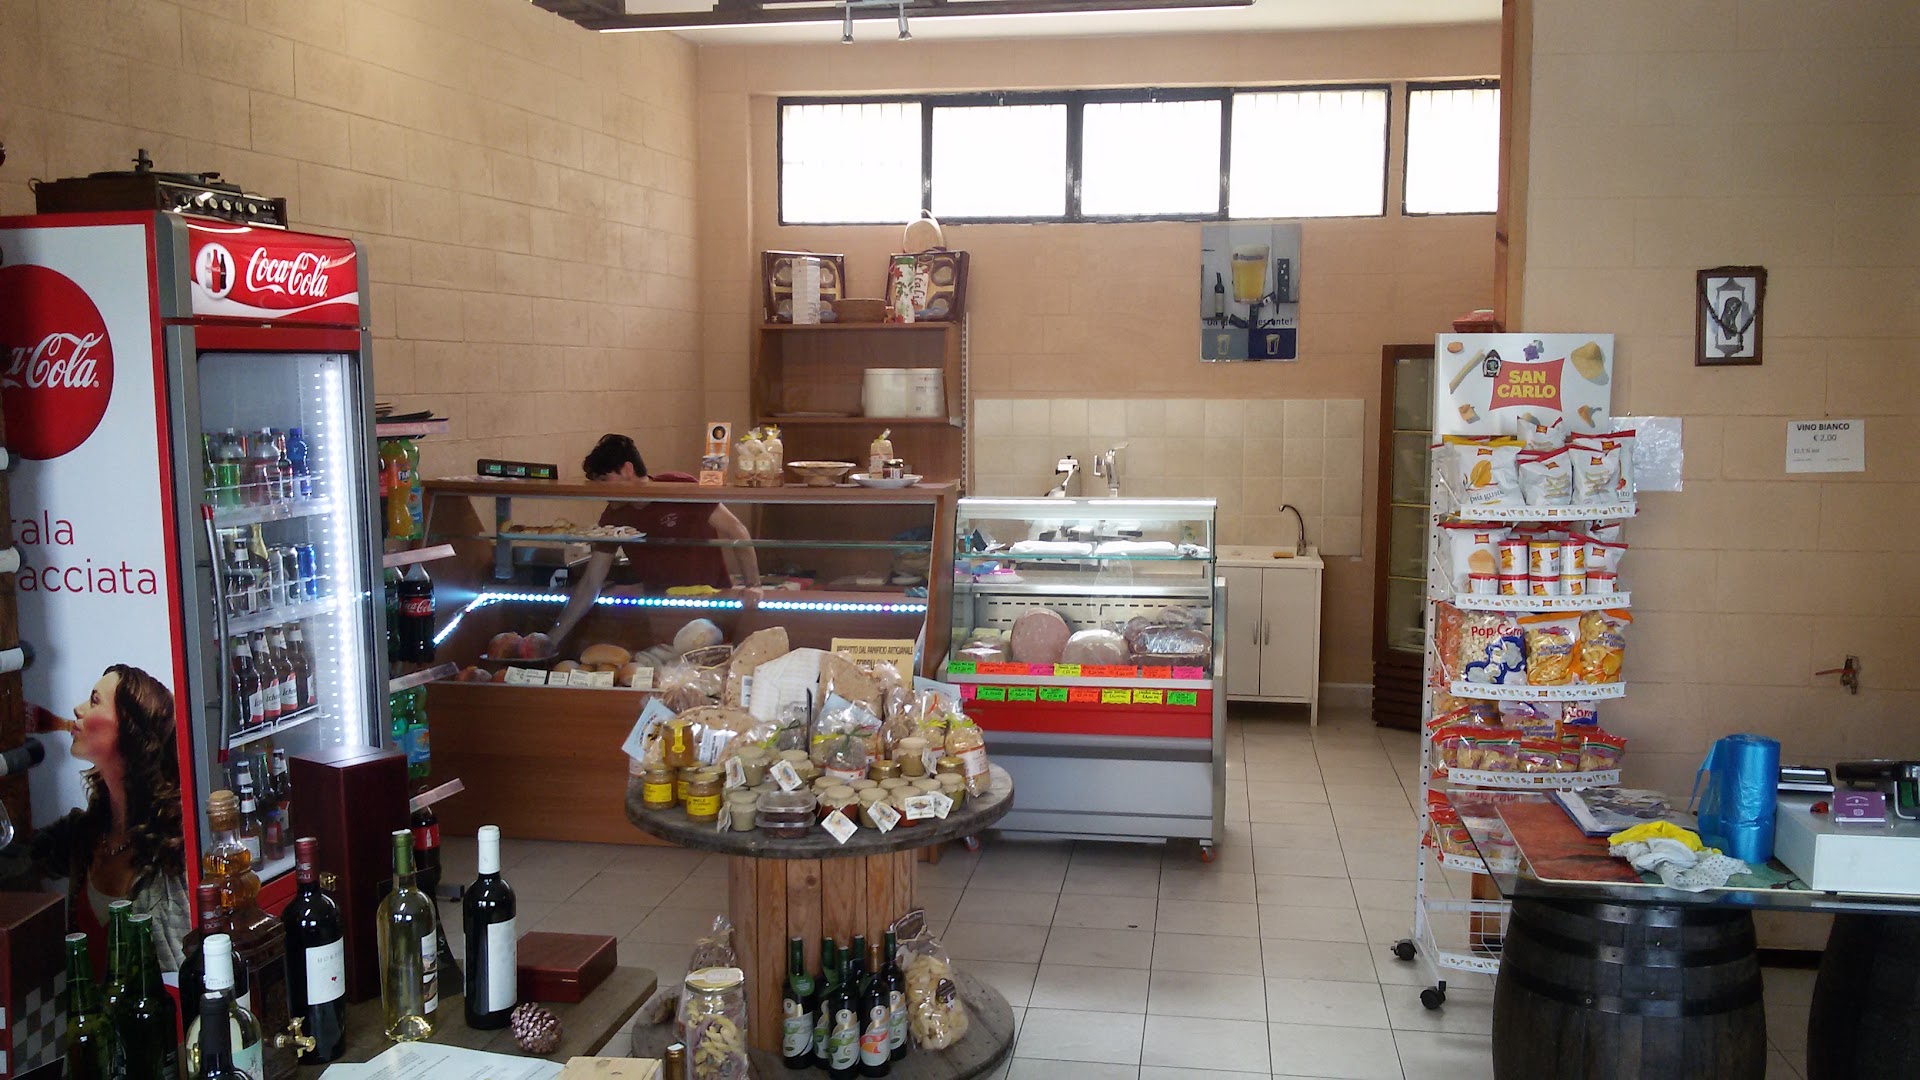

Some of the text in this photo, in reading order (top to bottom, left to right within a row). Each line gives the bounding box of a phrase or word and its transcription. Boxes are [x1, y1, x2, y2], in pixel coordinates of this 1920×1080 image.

[246, 247, 330, 297] Coca-Cola
[1509, 370, 1546, 384] SAN
[1497, 384, 1557, 398] CARLO
[1471, 624, 1523, 638] Pop Corn
